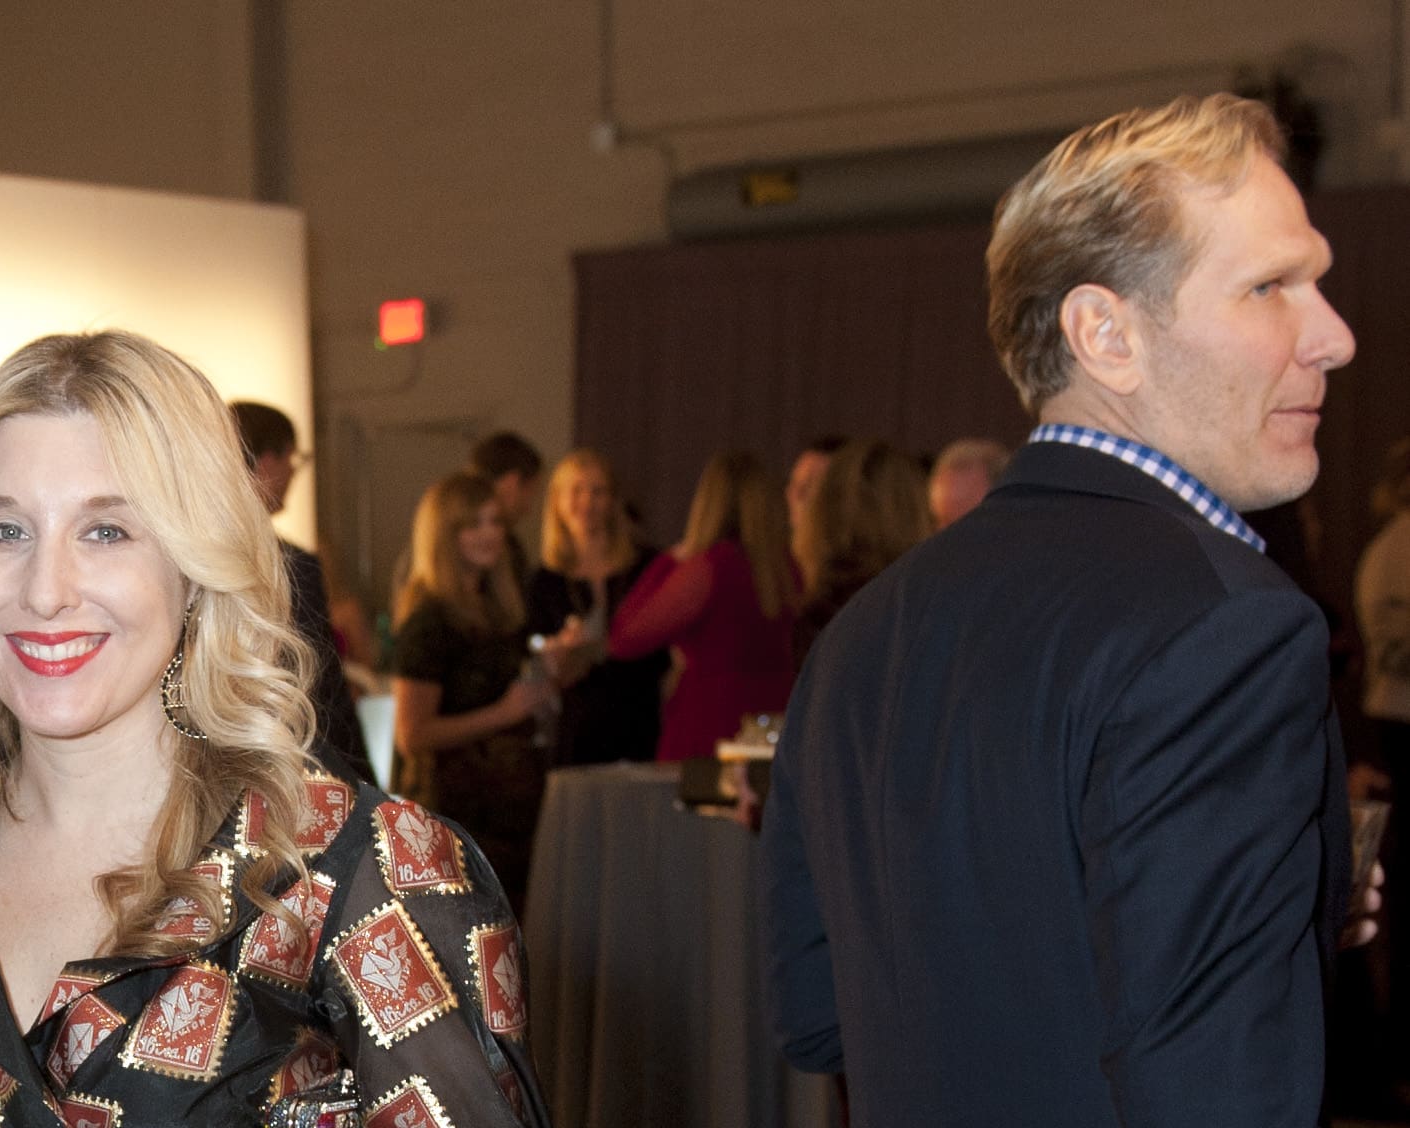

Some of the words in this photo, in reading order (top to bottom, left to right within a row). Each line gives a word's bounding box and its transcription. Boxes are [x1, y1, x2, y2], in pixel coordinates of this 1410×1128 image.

[398, 863, 414, 881] 16
[252, 943, 268, 962] 16
[417, 982, 436, 1000] 16
[492, 1010, 507, 1028] 16
[184, 1045, 203, 1065] 16
